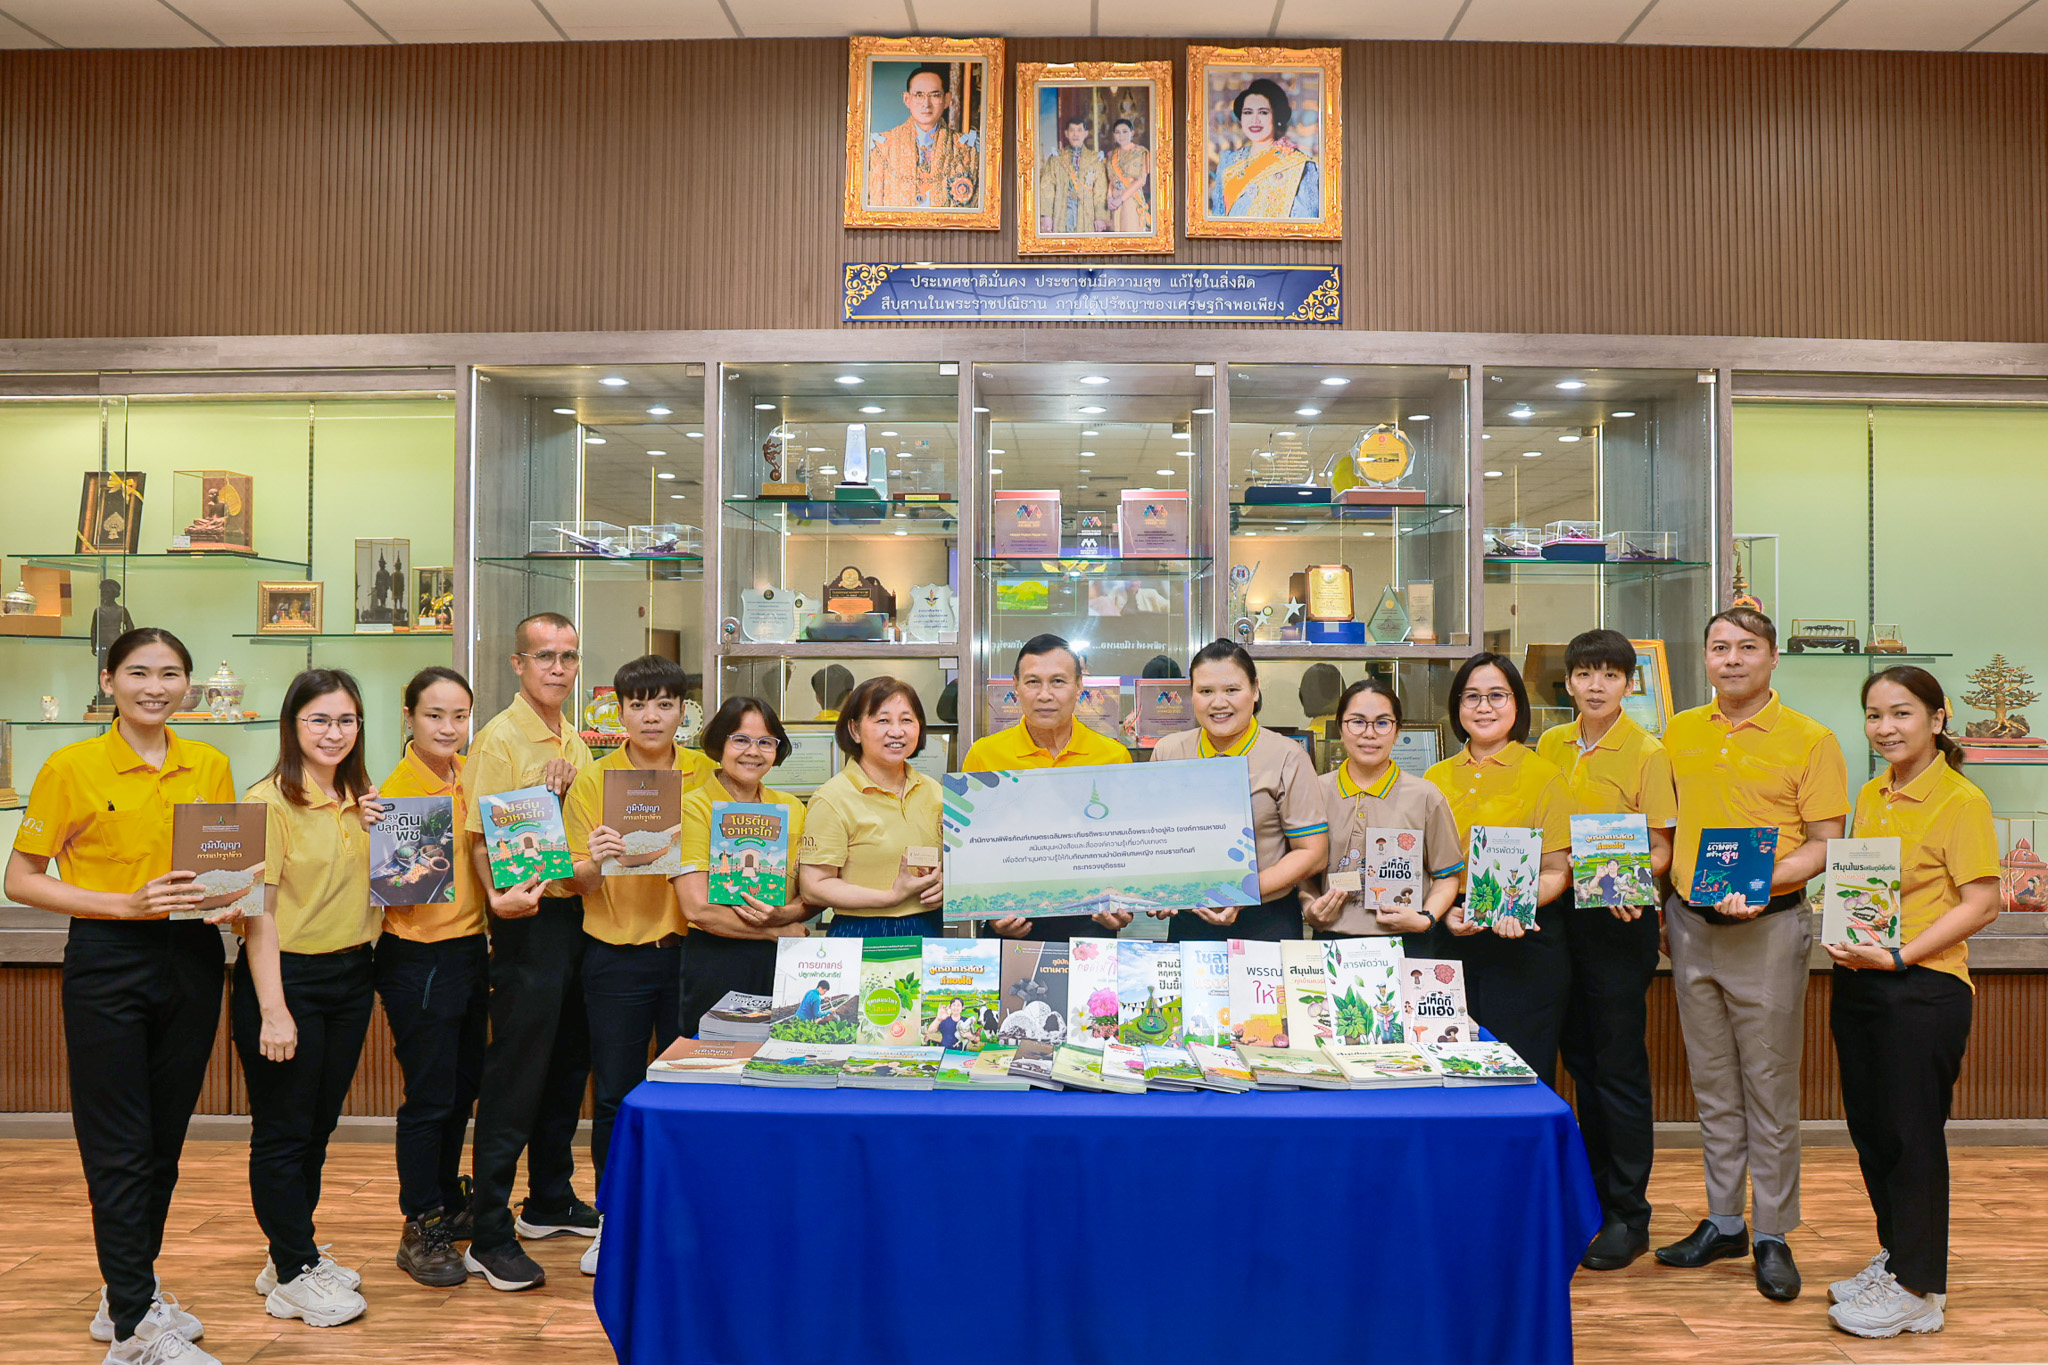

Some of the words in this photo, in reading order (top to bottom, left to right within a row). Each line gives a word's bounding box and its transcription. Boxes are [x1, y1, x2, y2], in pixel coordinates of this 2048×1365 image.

[911, 270, 1026, 288] ประเทศชาติมั่นคง
[1035, 274, 1162, 291] ประชาชนมีความสุข
[1170, 271, 1256, 289] แก้ไขในสิ่งผิด
[881, 294, 1048, 311] สืบสานในพระราชปณิธาน
[1055, 295, 1285, 314] ภายใต้ปรัชญาของเศรษฐกิจพอเพียง
[731, 815, 769, 827] โปรตีน
[728, 826, 773, 837] อาหารไก่
[200, 840, 242, 852] ภูมิปัญญา
[1343, 957, 1389, 969] สารพัดว่าน
[1246, 966, 1284, 977] พรรณ
